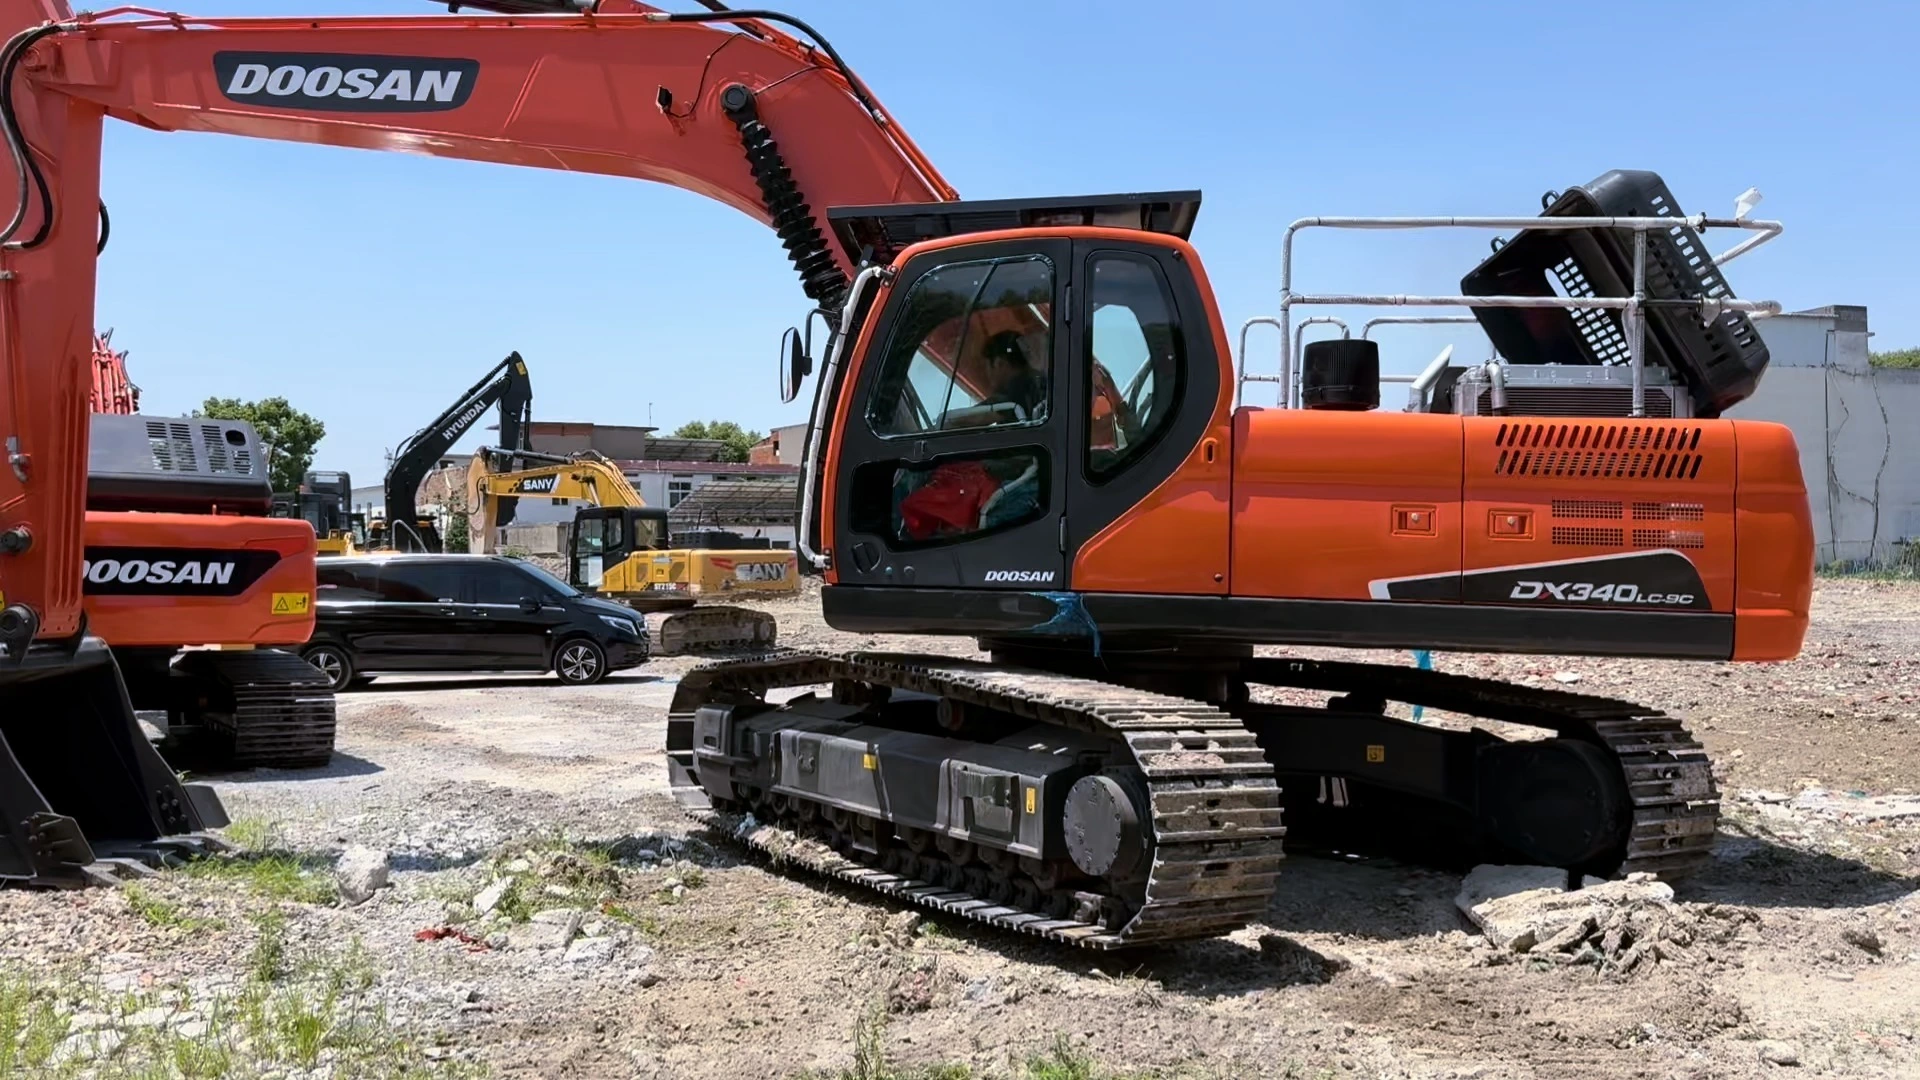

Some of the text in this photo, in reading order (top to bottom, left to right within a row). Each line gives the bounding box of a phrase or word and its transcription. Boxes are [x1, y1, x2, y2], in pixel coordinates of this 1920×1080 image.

[227, 64, 462, 102] DOOSAN
[442, 399, 487, 441] HYUNDAI
[523, 478, 553, 490] SANY
[83, 560, 235, 584] OOSAN
[736, 562, 787, 581] SANY
[984, 570, 1055, 582] DOOSAN
